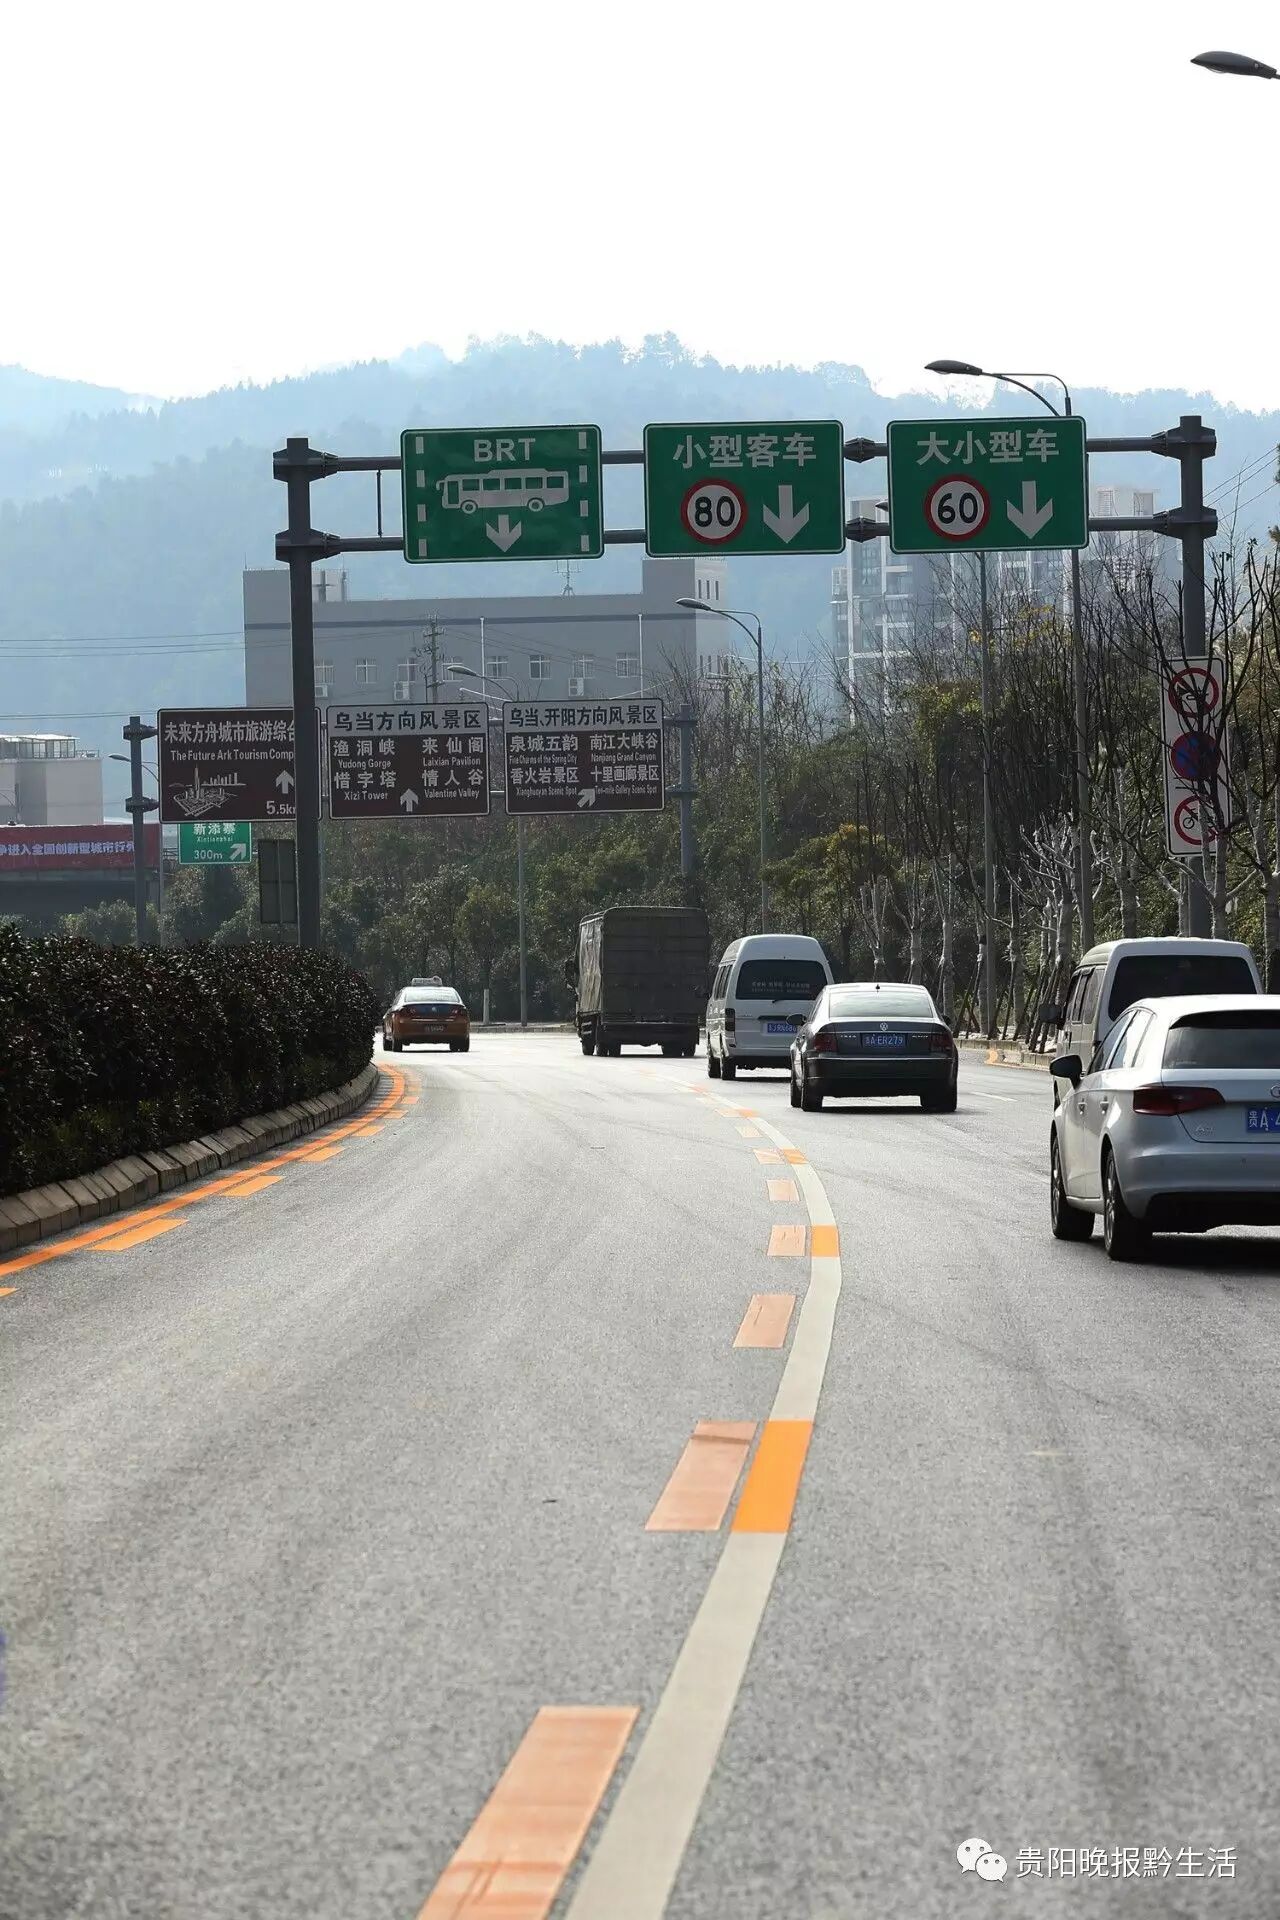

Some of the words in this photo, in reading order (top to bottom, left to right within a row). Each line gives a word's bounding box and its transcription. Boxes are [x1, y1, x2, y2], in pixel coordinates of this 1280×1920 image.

[473, 437, 536, 463] BRT
[673, 433, 817, 469] 小型客车
[916, 428, 1060, 466] 大小型车
[694, 496, 736, 528] 80
[937, 491, 980, 525] 60
[334, 710, 481, 731] 乌当方向风景区
[509, 705, 657, 727] 乌当、开阳方向风景区
[333, 738, 395, 757] 渔洞峡
[422, 736, 484, 755] 来仙阁
[510, 735, 578, 752] 泉城五韵
[590, 732, 658, 750] 南江大峡谷
[170, 750, 186, 761] The
[188, 750, 216, 761] Future
[217, 750, 232, 760] Ark
[233, 749, 268, 760] Tourism
[338, 759, 366, 770] Yudong
[368, 758, 391, 769] Gorge
[423, 757, 449, 767] Laixian
[451, 757, 481, 766] Pavilion
[617, 752, 634, 761] Grand
[635, 751, 656, 762] Canyon
[334, 771, 397, 789] 惜字塔
[422, 769, 484, 787] 情人谷
[510, 767, 579, 784] 香火岩景区
[590, 764, 659, 783] 十里画廊景区
[344, 791, 361, 800] Xizi
[362, 791, 389, 800] Tower
[425, 789, 457, 799] Valentine
[459, 788, 480, 799] Valley
[194, 849, 223, 860] 300m
